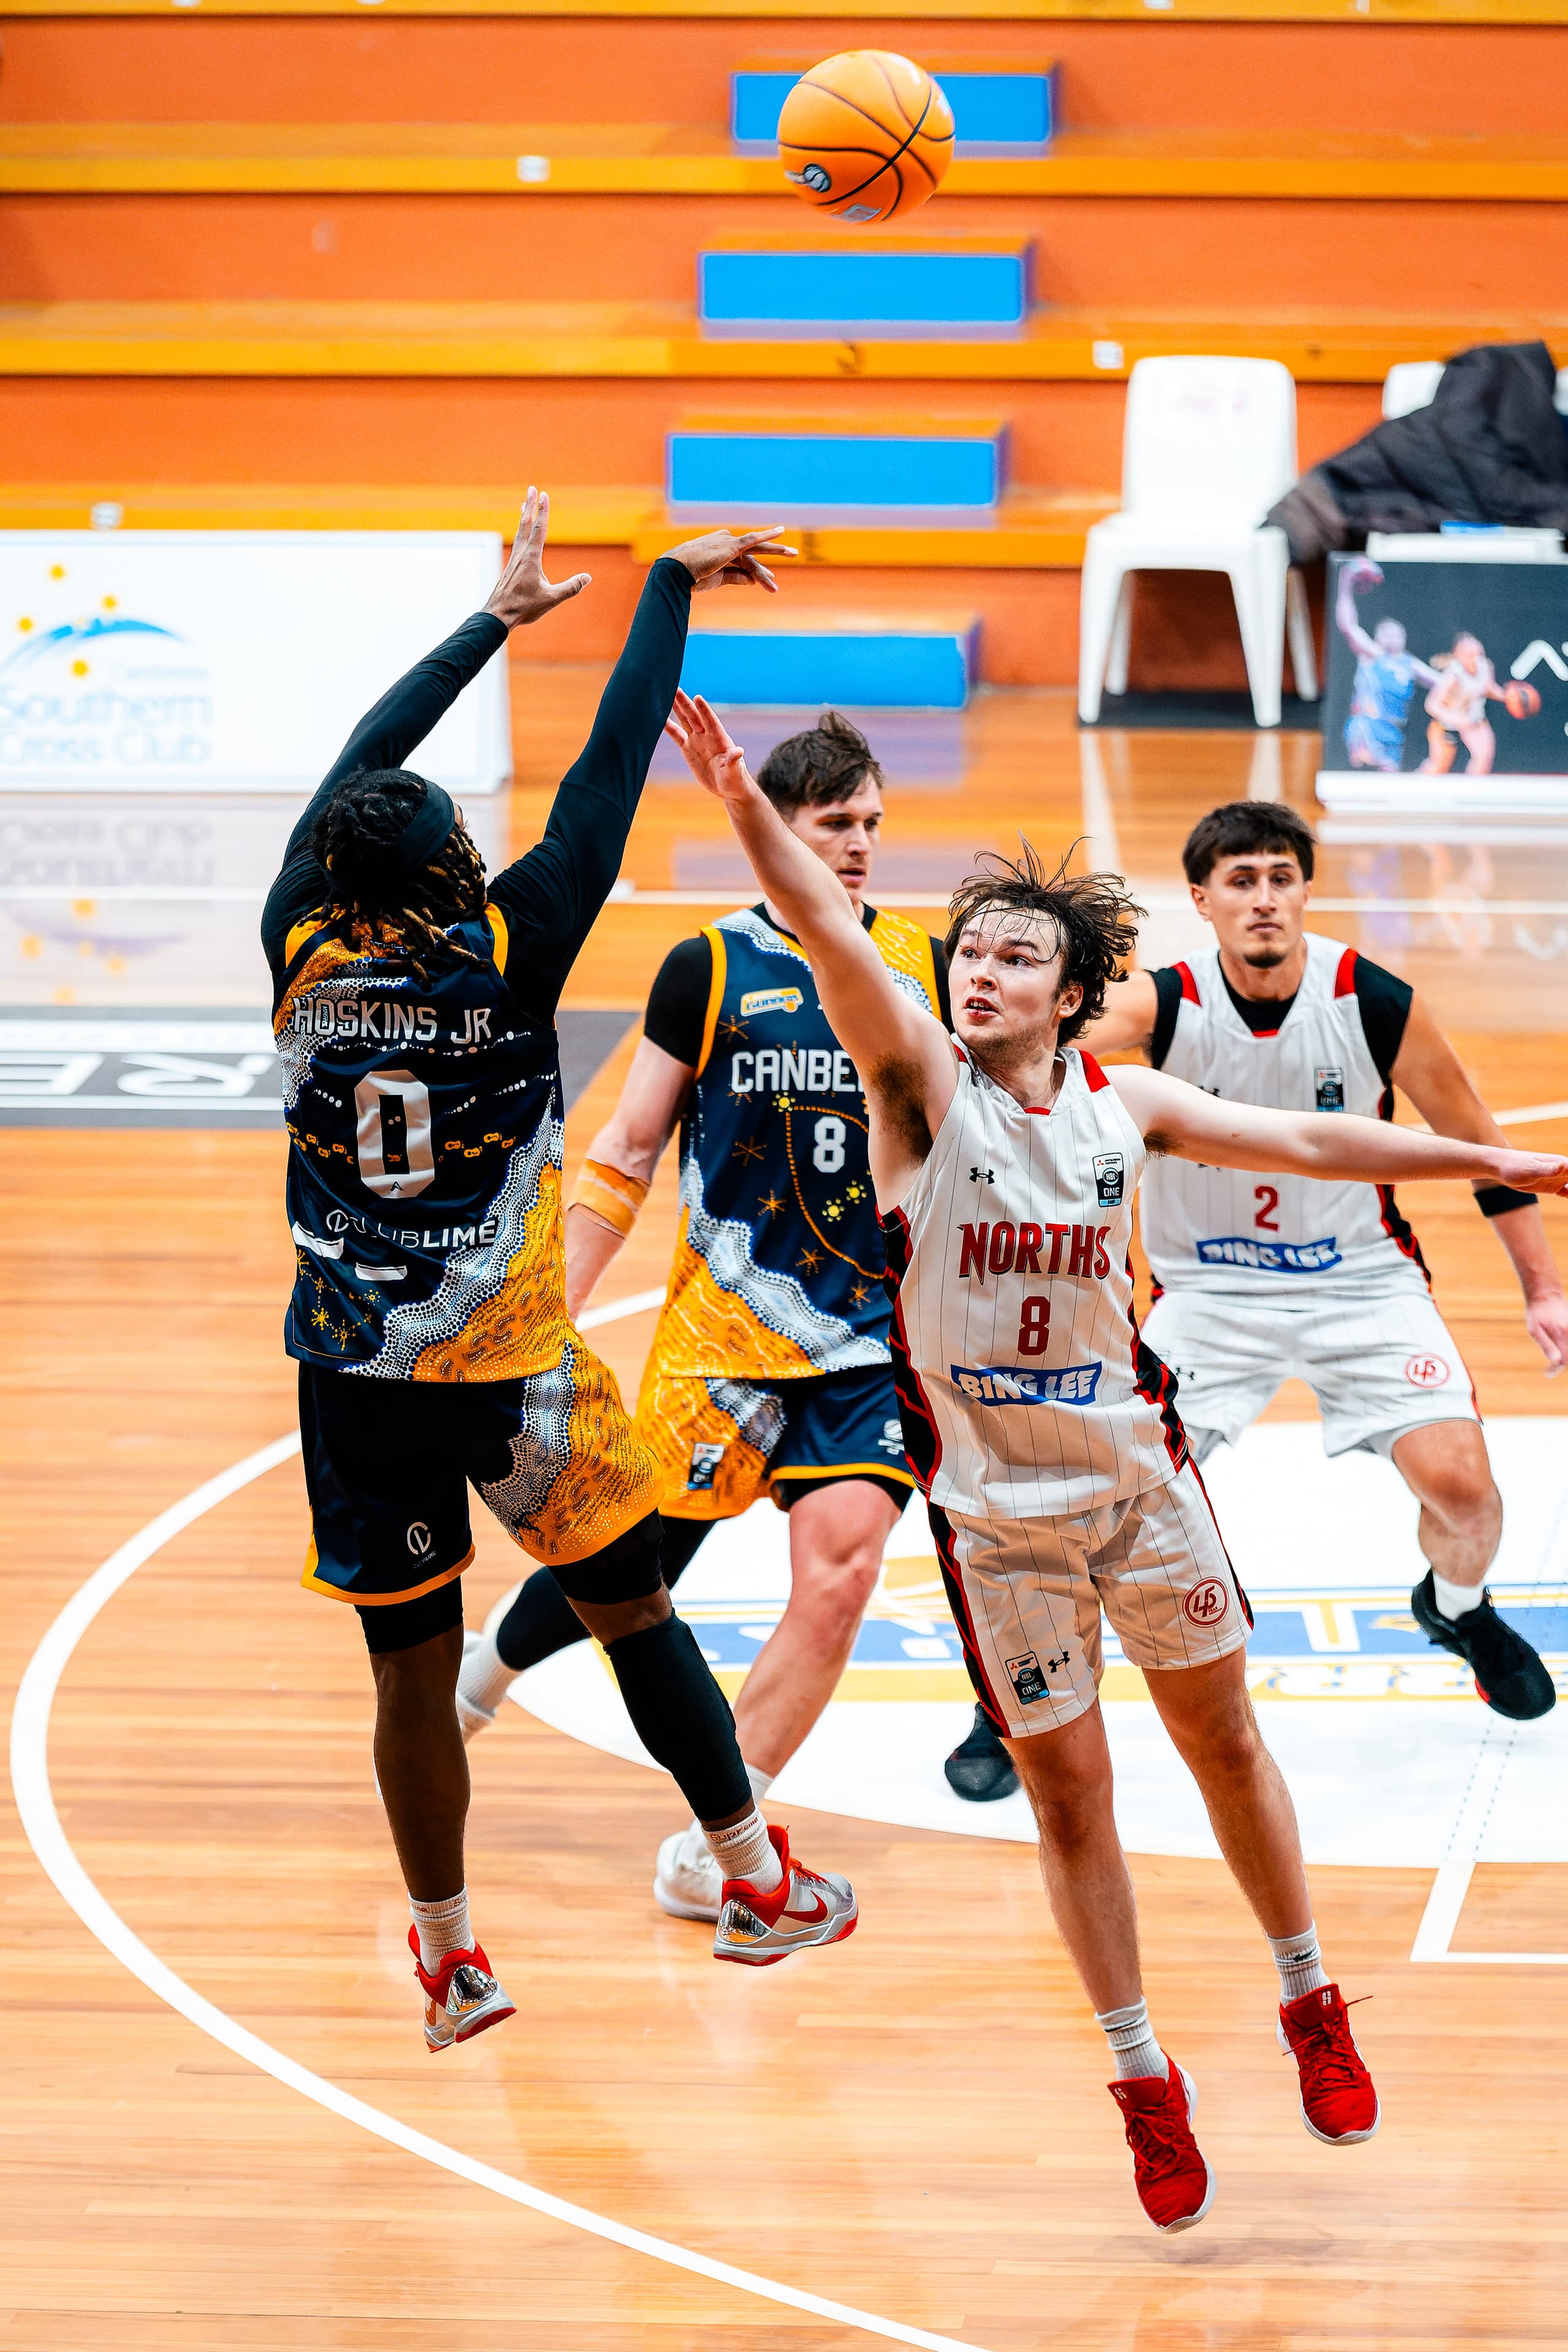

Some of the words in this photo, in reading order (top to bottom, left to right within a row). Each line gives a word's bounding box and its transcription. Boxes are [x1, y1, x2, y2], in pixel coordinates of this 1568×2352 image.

[293, 997, 437, 1041] HOSKINS
[451, 1008, 492, 1044] JR
[354, 1069, 435, 1199] 0
[813, 1116, 846, 1174] 8
[1102, 1186, 1120, 1197] ONE
[1254, 1185, 1280, 1232] 2
[957, 1220, 1112, 1286] NORTHS
[1017, 1295, 1051, 1356] 8
[958, 1373, 1038, 1400] BING
[1044, 1369, 1097, 1400] LEE
